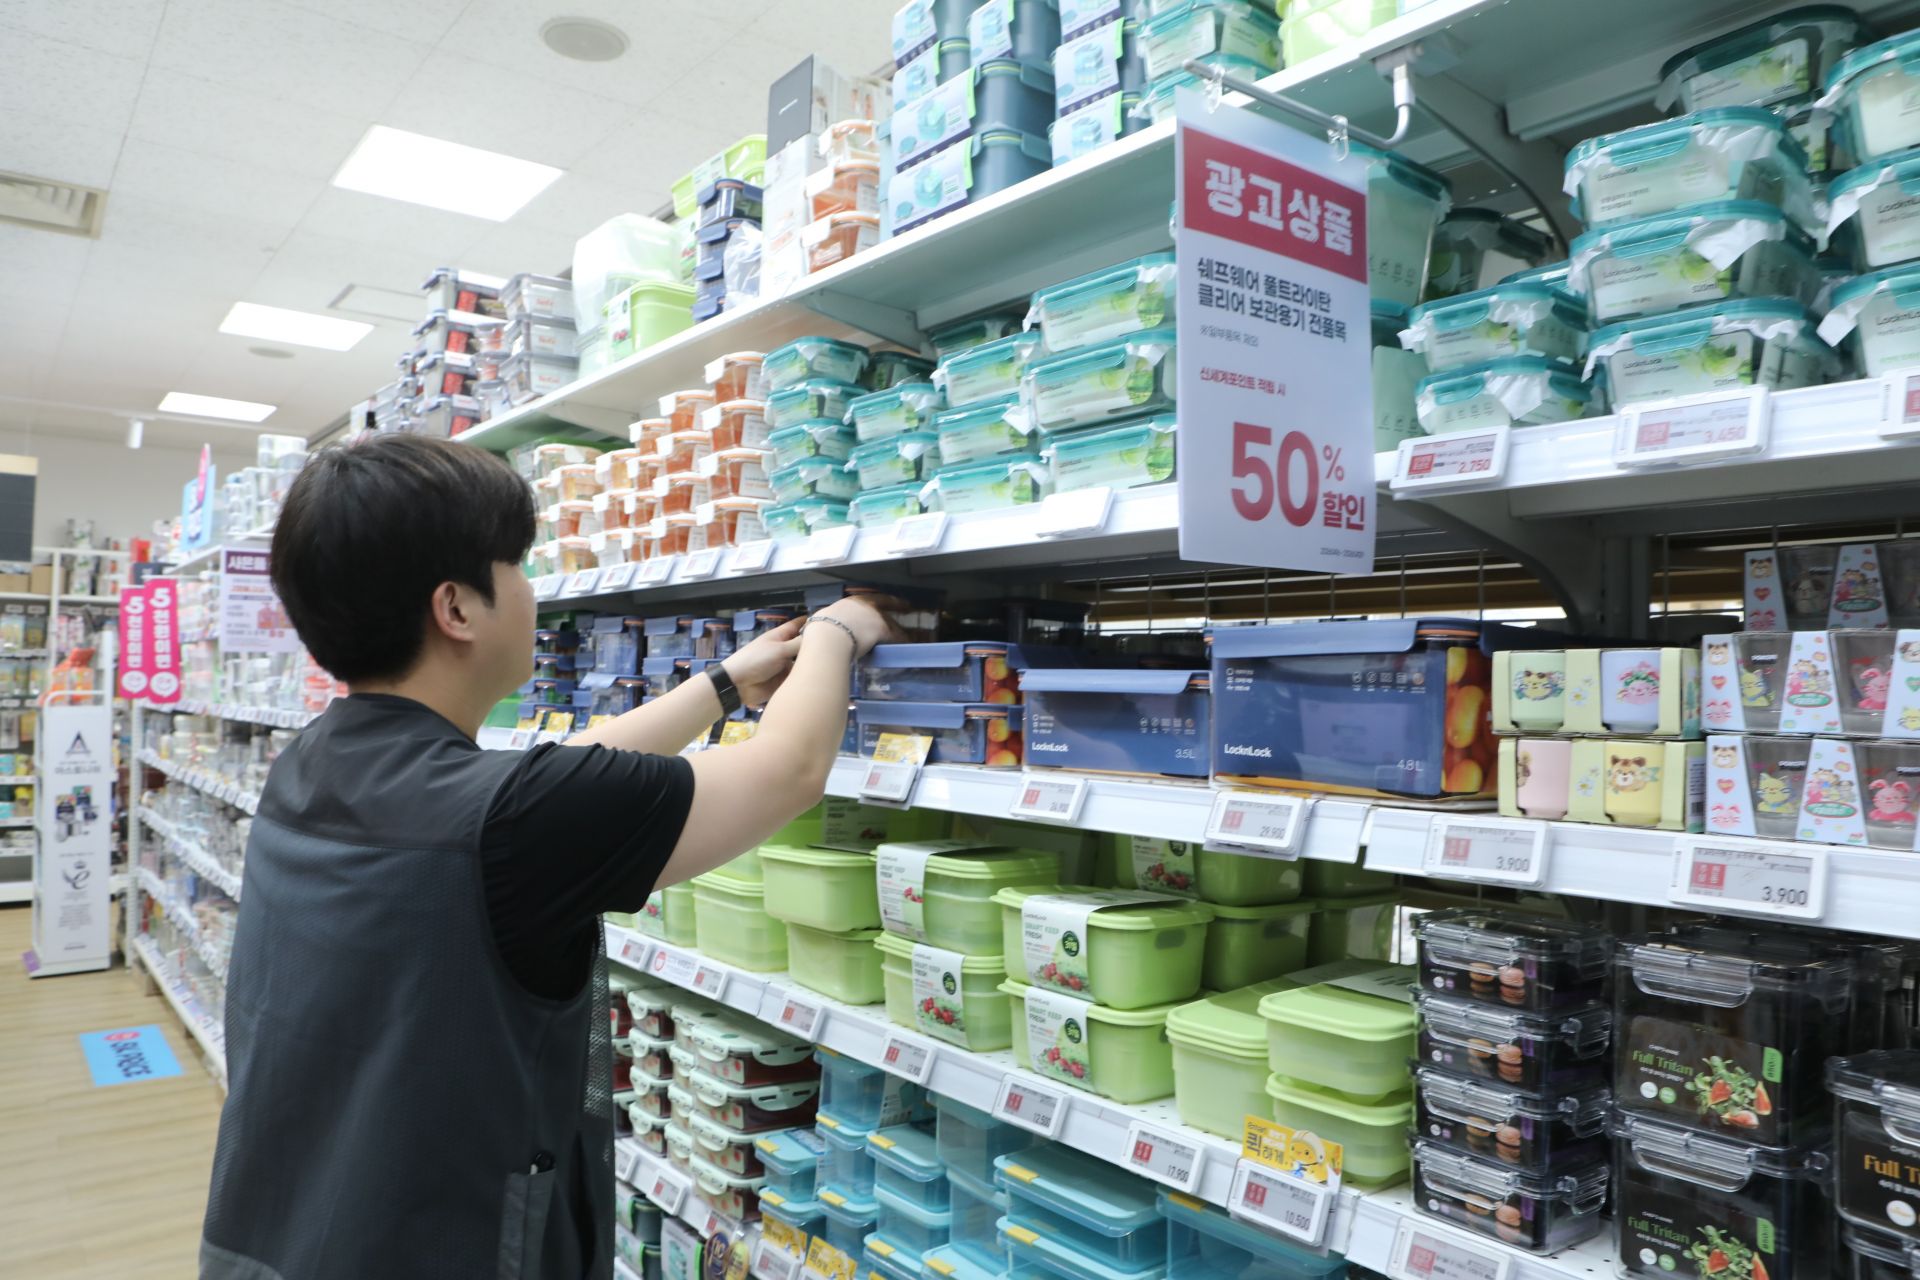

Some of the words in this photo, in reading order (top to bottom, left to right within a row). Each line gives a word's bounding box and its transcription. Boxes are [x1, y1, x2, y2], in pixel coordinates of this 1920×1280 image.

[1205, 159, 1352, 256] 광고상품
[1197, 257, 1260, 293] 쉐프웨어
[1198, 283, 1245, 315] 클리어
[1249, 296, 1305, 331] 보관용기
[1309, 313, 1347, 342] 전품목
[1277, 383, 1287, 397] 시
[1231, 421, 1345, 527] 50%
[1322, 491, 1365, 532] 할인
[1031, 741, 1070, 753] LocknLock
[1223, 743, 1272, 759] LocknLock
[1396, 759, 1425, 772] 4.8L
[1761, 886, 1808, 906] 3,900
[1025, 930, 1043, 940] FRESH
[1029, 1015, 1046, 1025] FRESH
[1631, 1049, 1655, 1066] Full
[1656, 1055, 1694, 1077] Tritan
[1863, 1153, 1900, 1179] Full
[1285, 1209, 1311, 1231] 10,500
[1627, 1216, 1650, 1233] Full
[1651, 1223, 1690, 1245] Tritan
